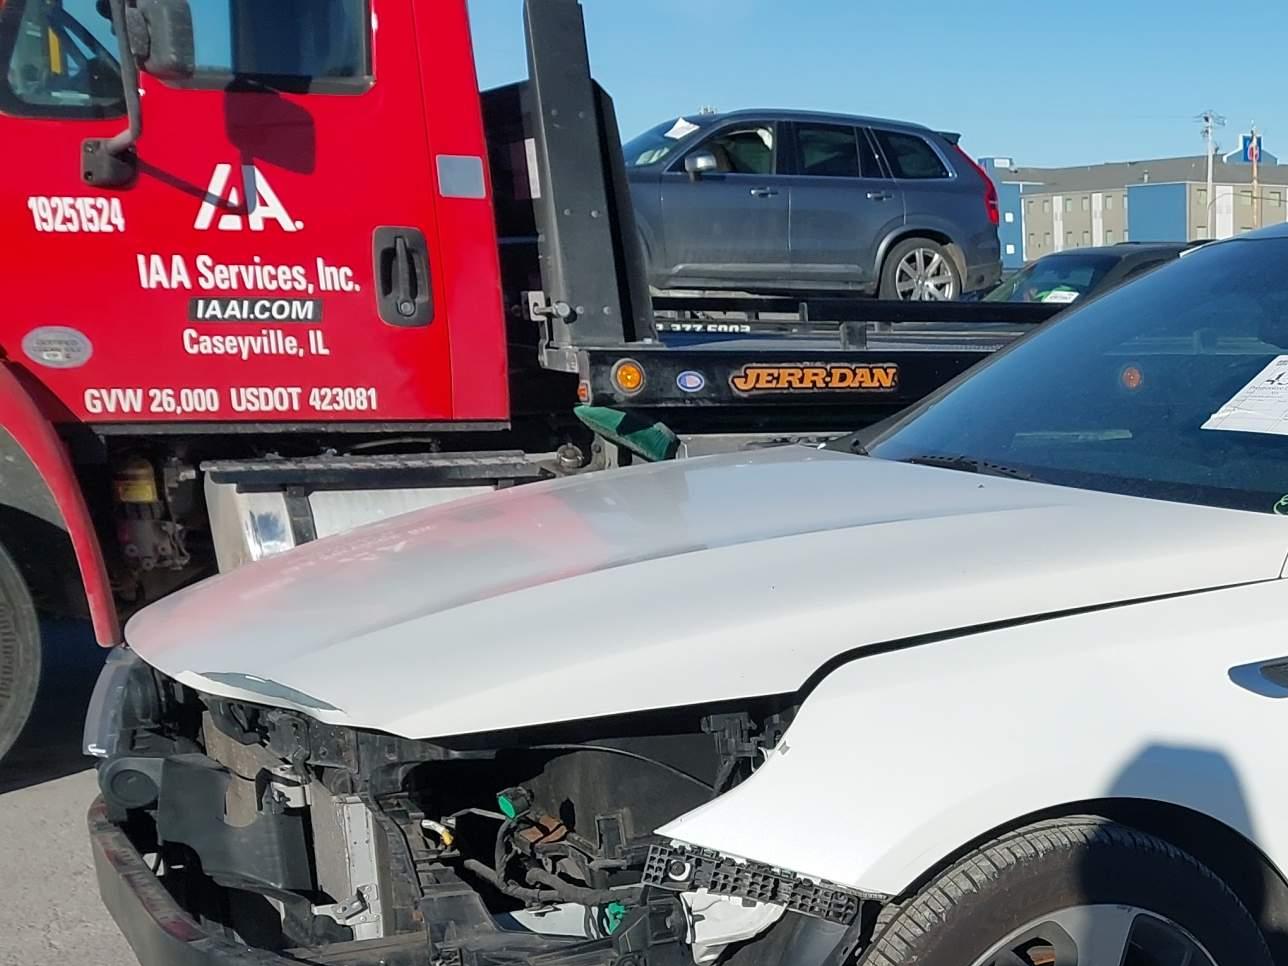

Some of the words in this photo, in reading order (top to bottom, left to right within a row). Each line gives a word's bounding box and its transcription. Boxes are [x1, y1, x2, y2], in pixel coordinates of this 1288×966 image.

[27, 196, 125, 232] 19251524
[137, 254, 192, 289] IAA
[196, 255, 314, 294] Services,
[316, 257, 361, 292] Inc.
[197, 299, 314, 320] IAAI.COM
[183, 328, 304, 360] Caseyville,
[308, 329, 330, 355] IL
[84, 388, 143, 413] GVW
[149, 388, 219, 415] 26,000
[230, 387, 302, 411] USDOT
[309, 387, 378, 411] 423081
